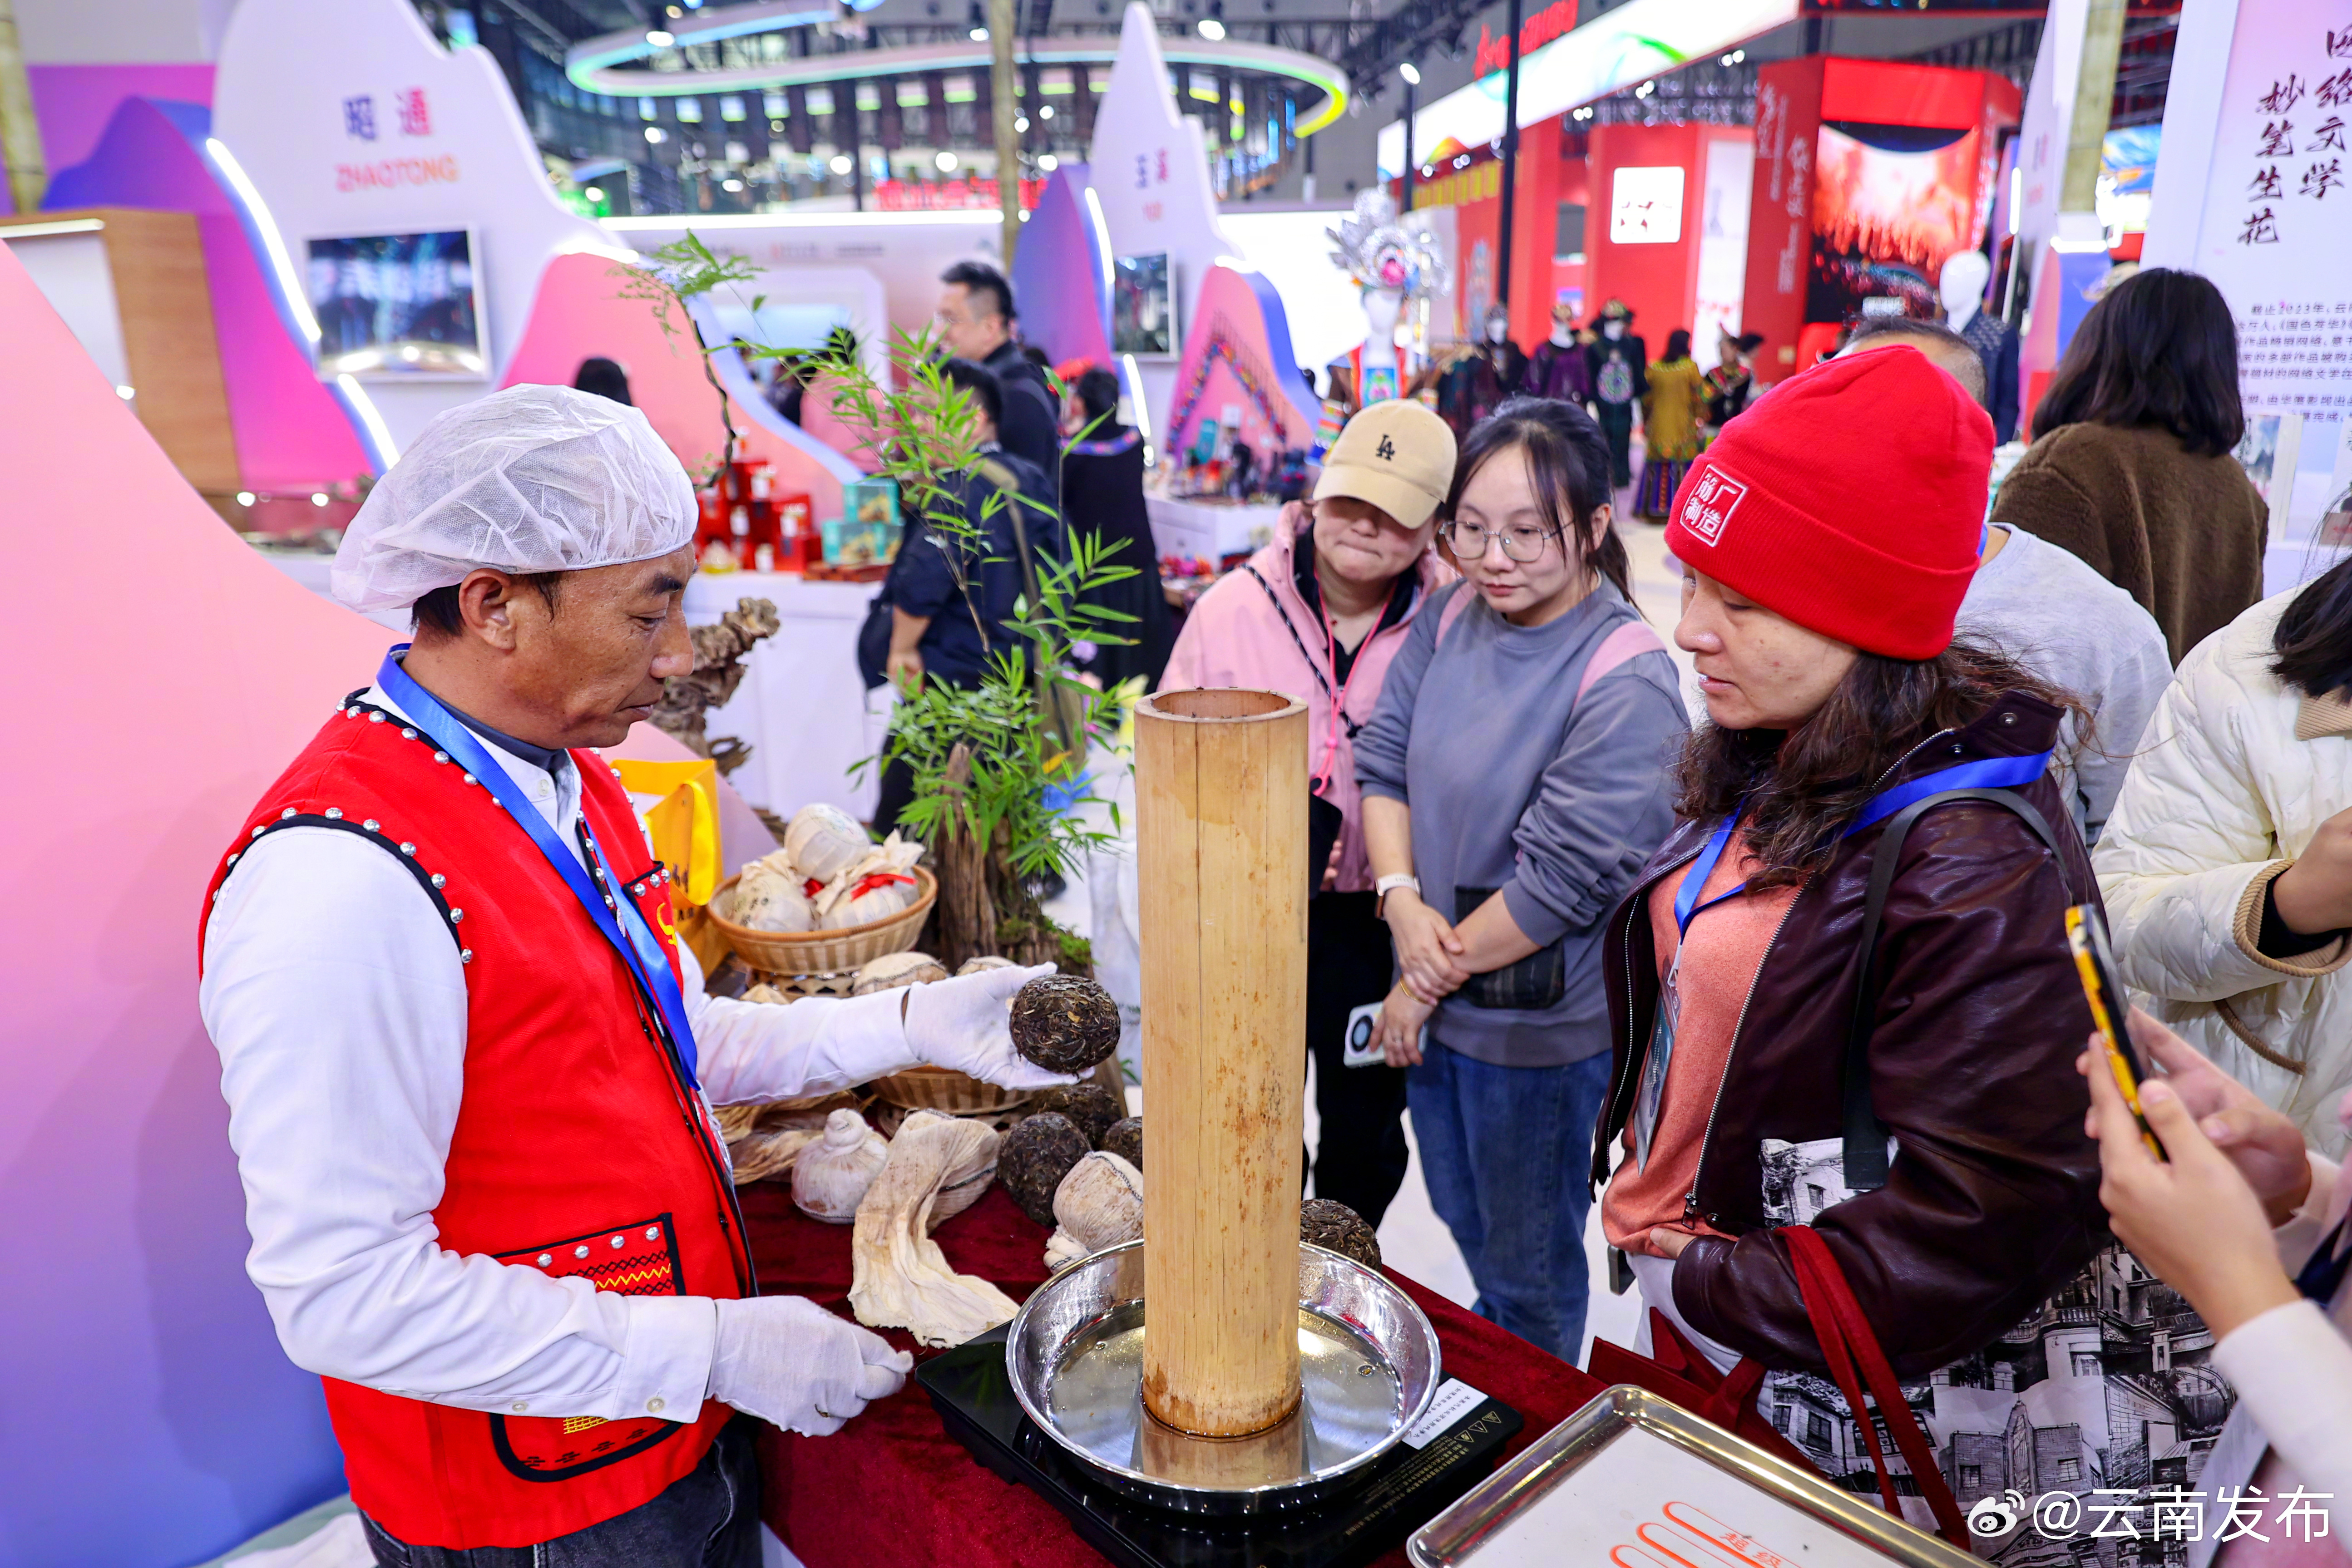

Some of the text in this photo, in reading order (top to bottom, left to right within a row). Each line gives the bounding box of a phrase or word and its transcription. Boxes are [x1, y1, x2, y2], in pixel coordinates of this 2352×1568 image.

[343, 86, 433, 140] 昭通
[336, 154, 460, 192] ZHAOTONG
[2238, 72, 2305, 247] 妙笔生花
[1376, 434, 1395, 461] LA
[1685, 497, 1722, 538] 制造
[1719, 1532, 1782, 1568] 超级
